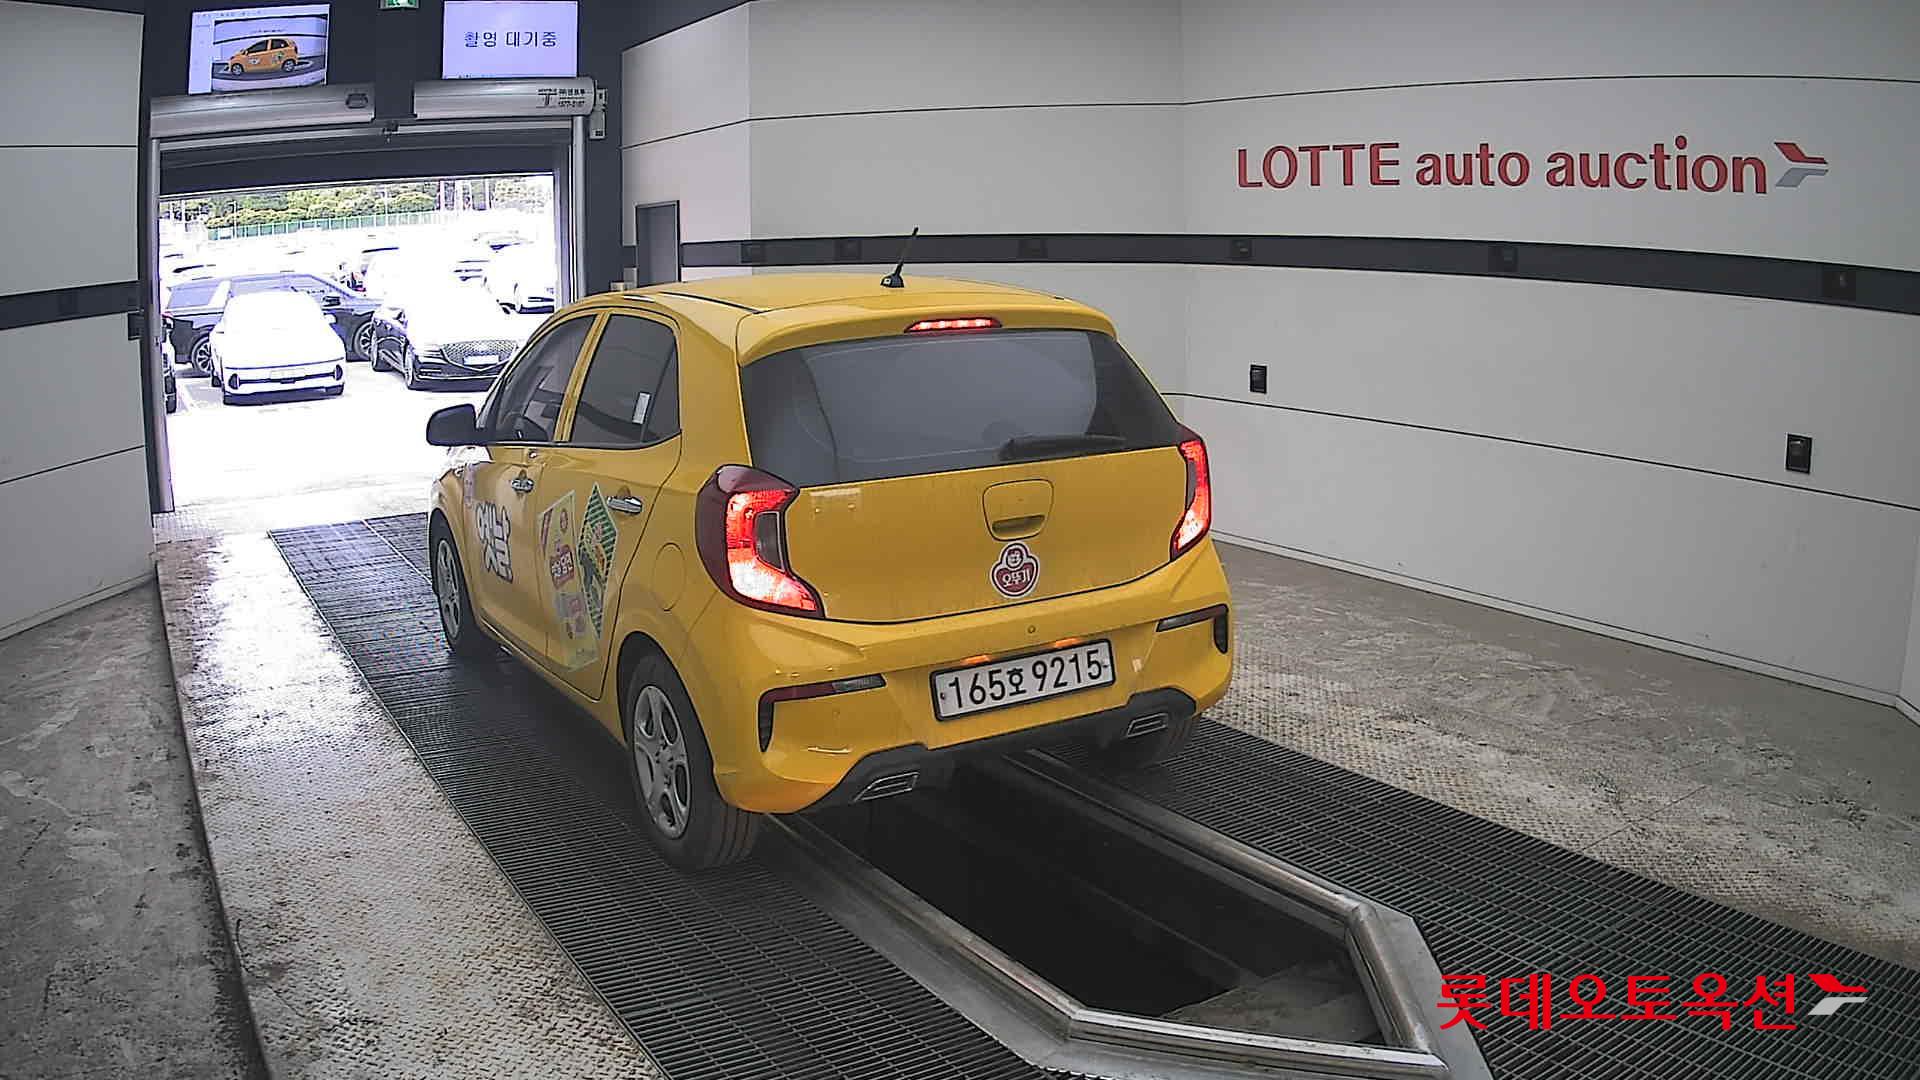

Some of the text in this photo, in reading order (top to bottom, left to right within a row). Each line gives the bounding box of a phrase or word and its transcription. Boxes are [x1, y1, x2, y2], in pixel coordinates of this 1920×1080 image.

[464, 31, 558, 48] 촬영 대기중
[1237, 136, 1767, 194] LOTTE auto auction
[1001, 568, 1031, 588] 오뚜기
[948, 649, 1101, 709] 165호 9215
